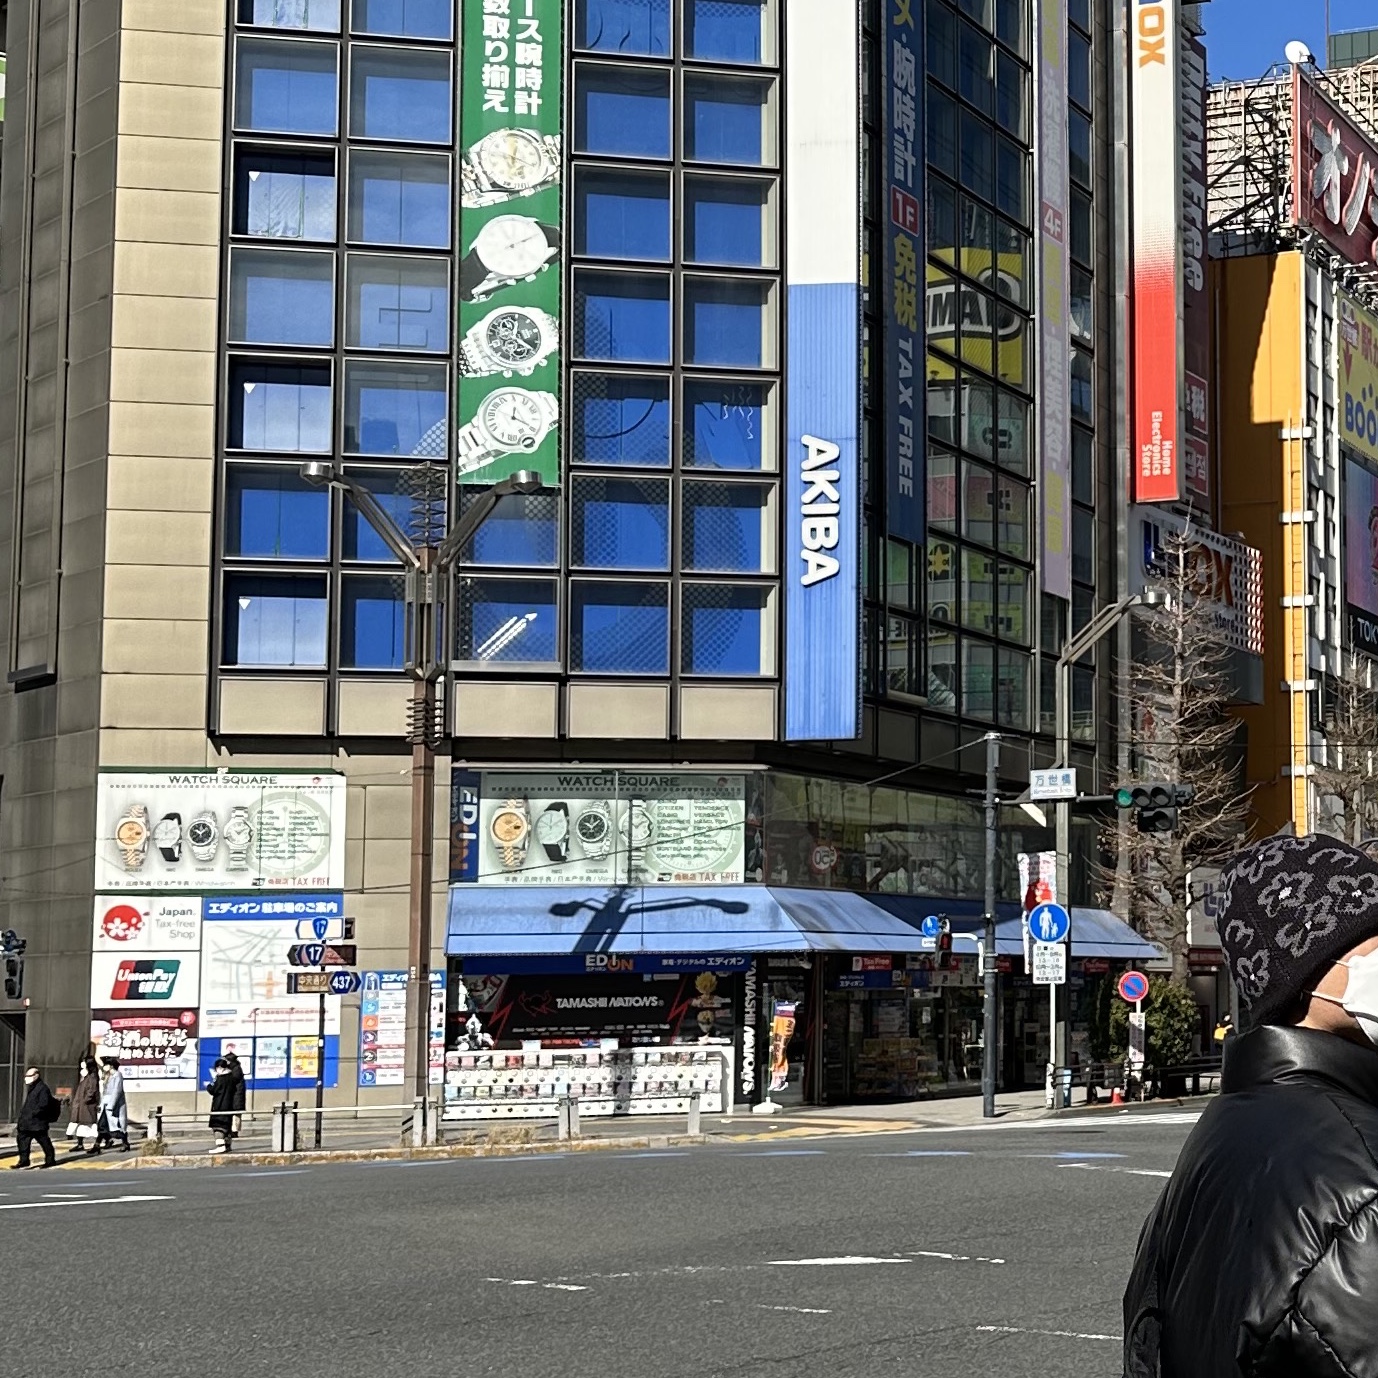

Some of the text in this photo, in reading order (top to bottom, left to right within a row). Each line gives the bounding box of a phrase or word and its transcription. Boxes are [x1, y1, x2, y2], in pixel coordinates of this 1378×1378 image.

[894, 192, 917, 230] 1F
[1043, 206, 1062, 240] 4F
[898, 336, 913, 411] TAX
[1151, 410, 1163, 476] Electronics
[898, 413, 913, 498] FREE
[1141, 444, 1153, 477] Store
[1161, 440, 1173, 476] Home
[801, 434, 840, 586] AKIBA
[168, 775, 278, 786] WATCH SQUARE
[558, 776, 681, 788] WATCH SQUARE
[1035, 773, 1071, 786] 万世橋
[293, 877, 309, 886] TAX
[699, 872, 717, 882] TAX
[208, 901, 338, 914] エディオン 駐車場のご案内
[155, 918, 196, 928] Tax-free
[169, 929, 196, 940] Shop
[308, 946, 323, 962] 17
[706, 956, 745, 967] エディオン
[117, 968, 177, 981] UnionPay
[331, 974, 350, 990] 437
[556, 996, 658, 1009] TAMASHII NATIONS
[118, 1047, 178, 1060] 始めました
